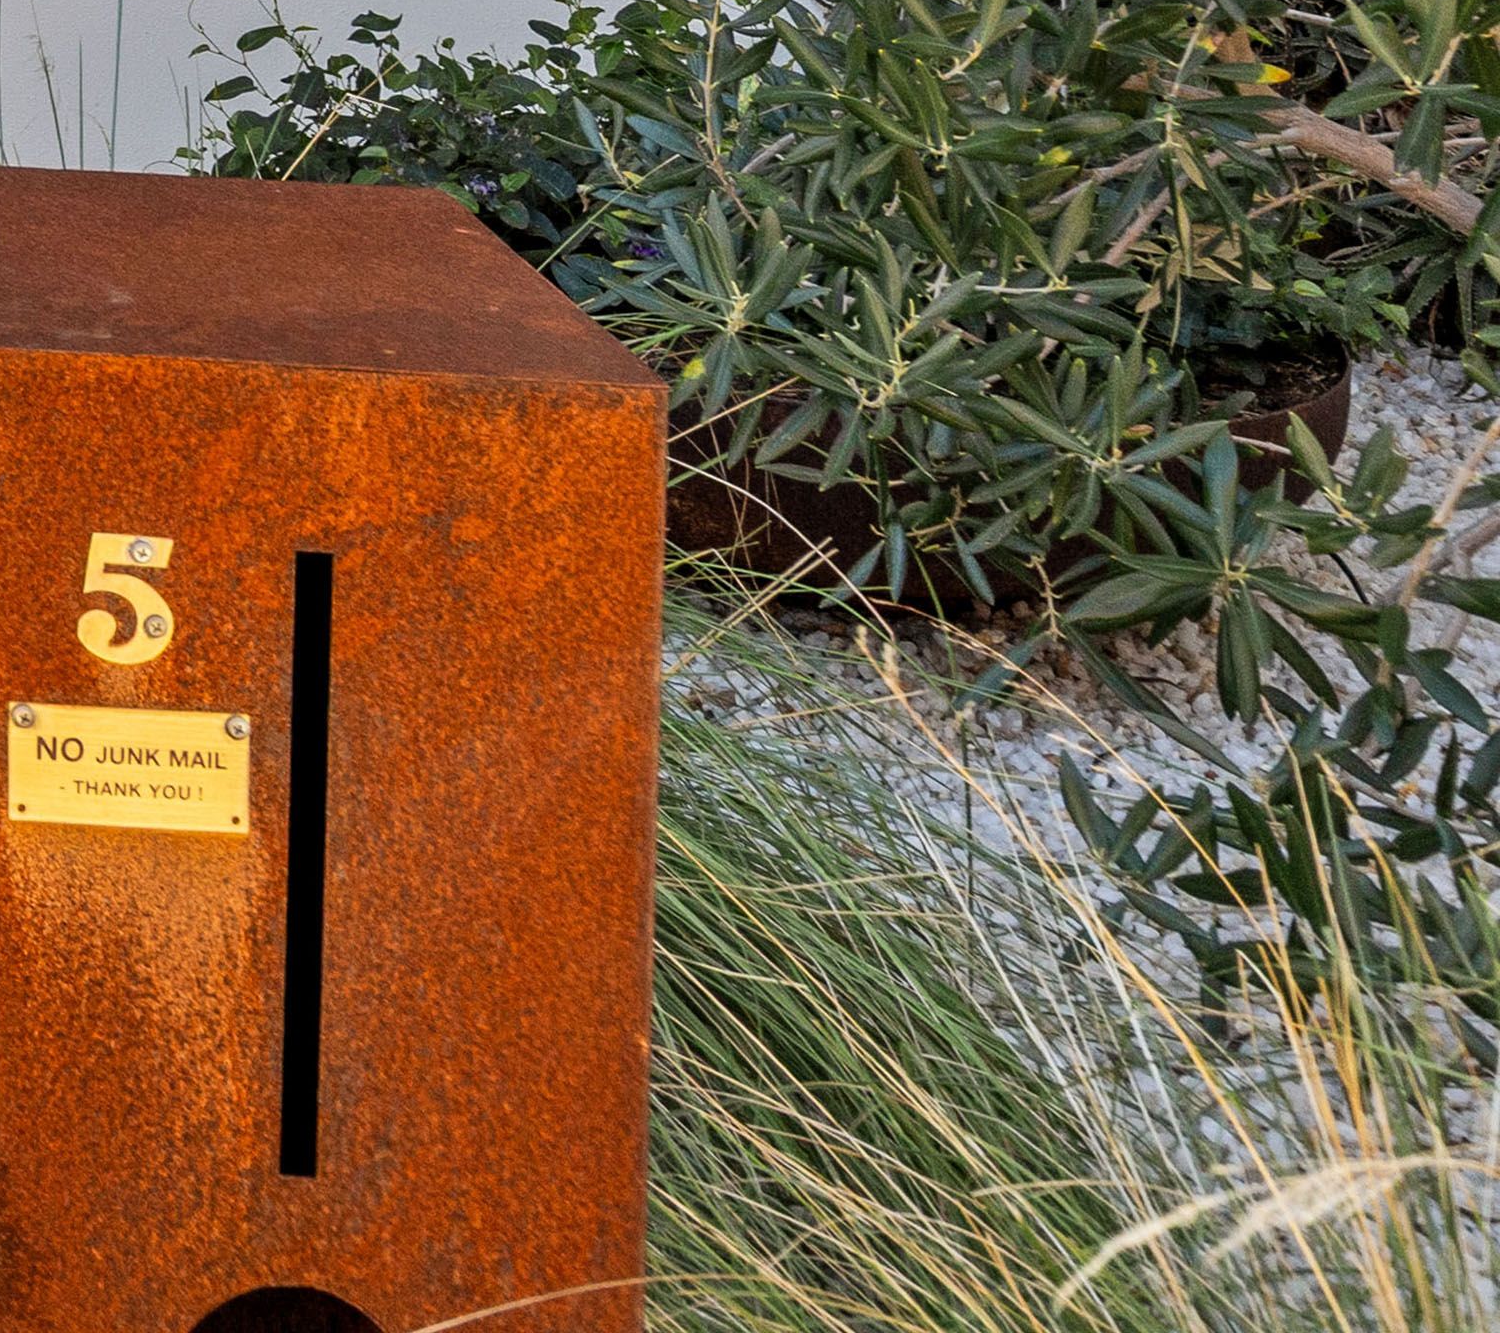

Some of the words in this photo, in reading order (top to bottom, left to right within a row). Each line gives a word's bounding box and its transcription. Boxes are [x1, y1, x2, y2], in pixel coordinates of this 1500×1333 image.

[76, 532, 175, 665] 5
[36, 736, 85, 763] NO
[96, 746, 161, 767] JUNK
[169, 749, 228, 770] MAIL
[73, 779, 141, 798] THANK
[149, 784, 192, 801] YOU
